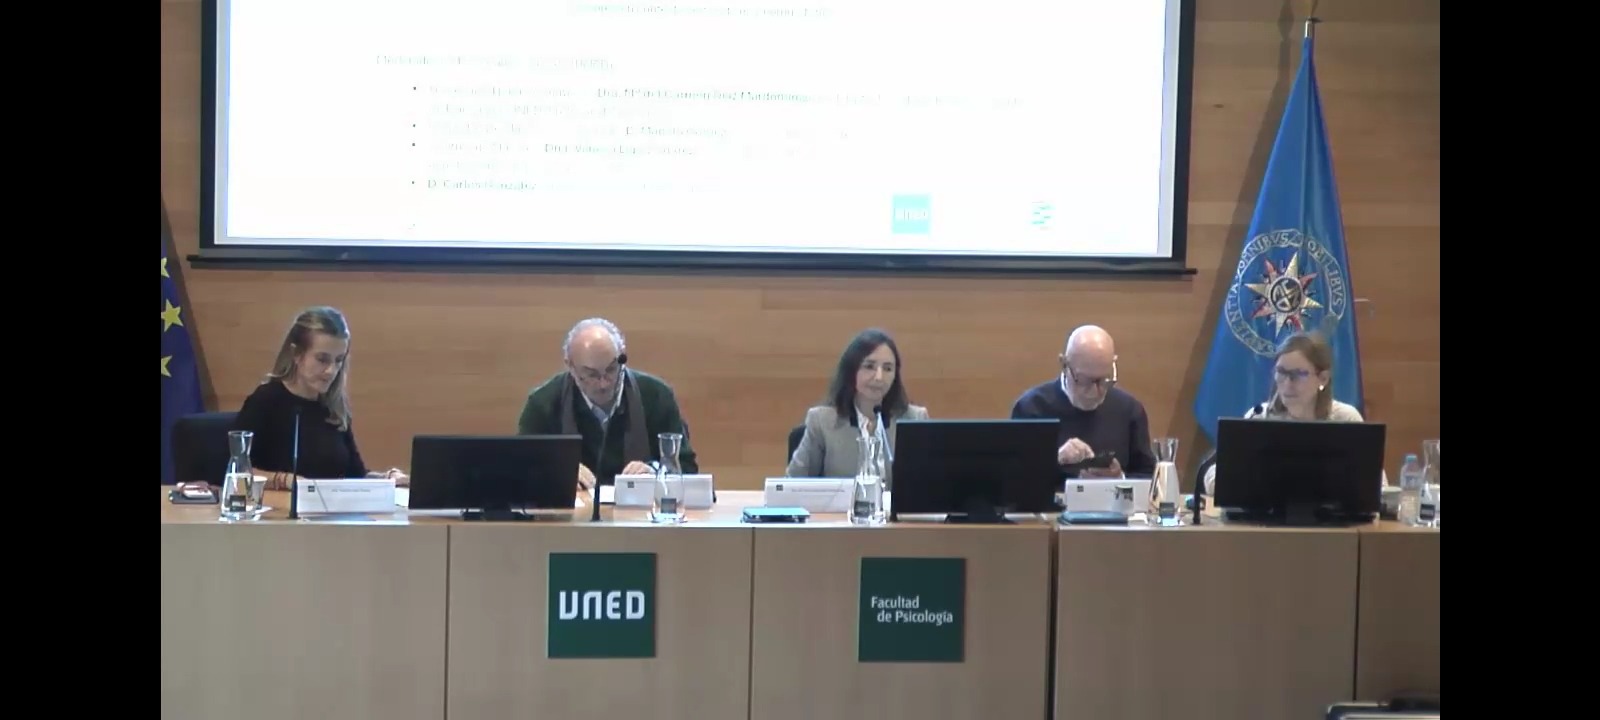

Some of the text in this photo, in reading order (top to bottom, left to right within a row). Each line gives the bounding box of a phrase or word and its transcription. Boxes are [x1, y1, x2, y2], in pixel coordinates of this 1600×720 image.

[559, 590, 645, 620] UNED
[871, 595, 920, 609] Facultad
[877, 608, 954, 627] de Psicología
